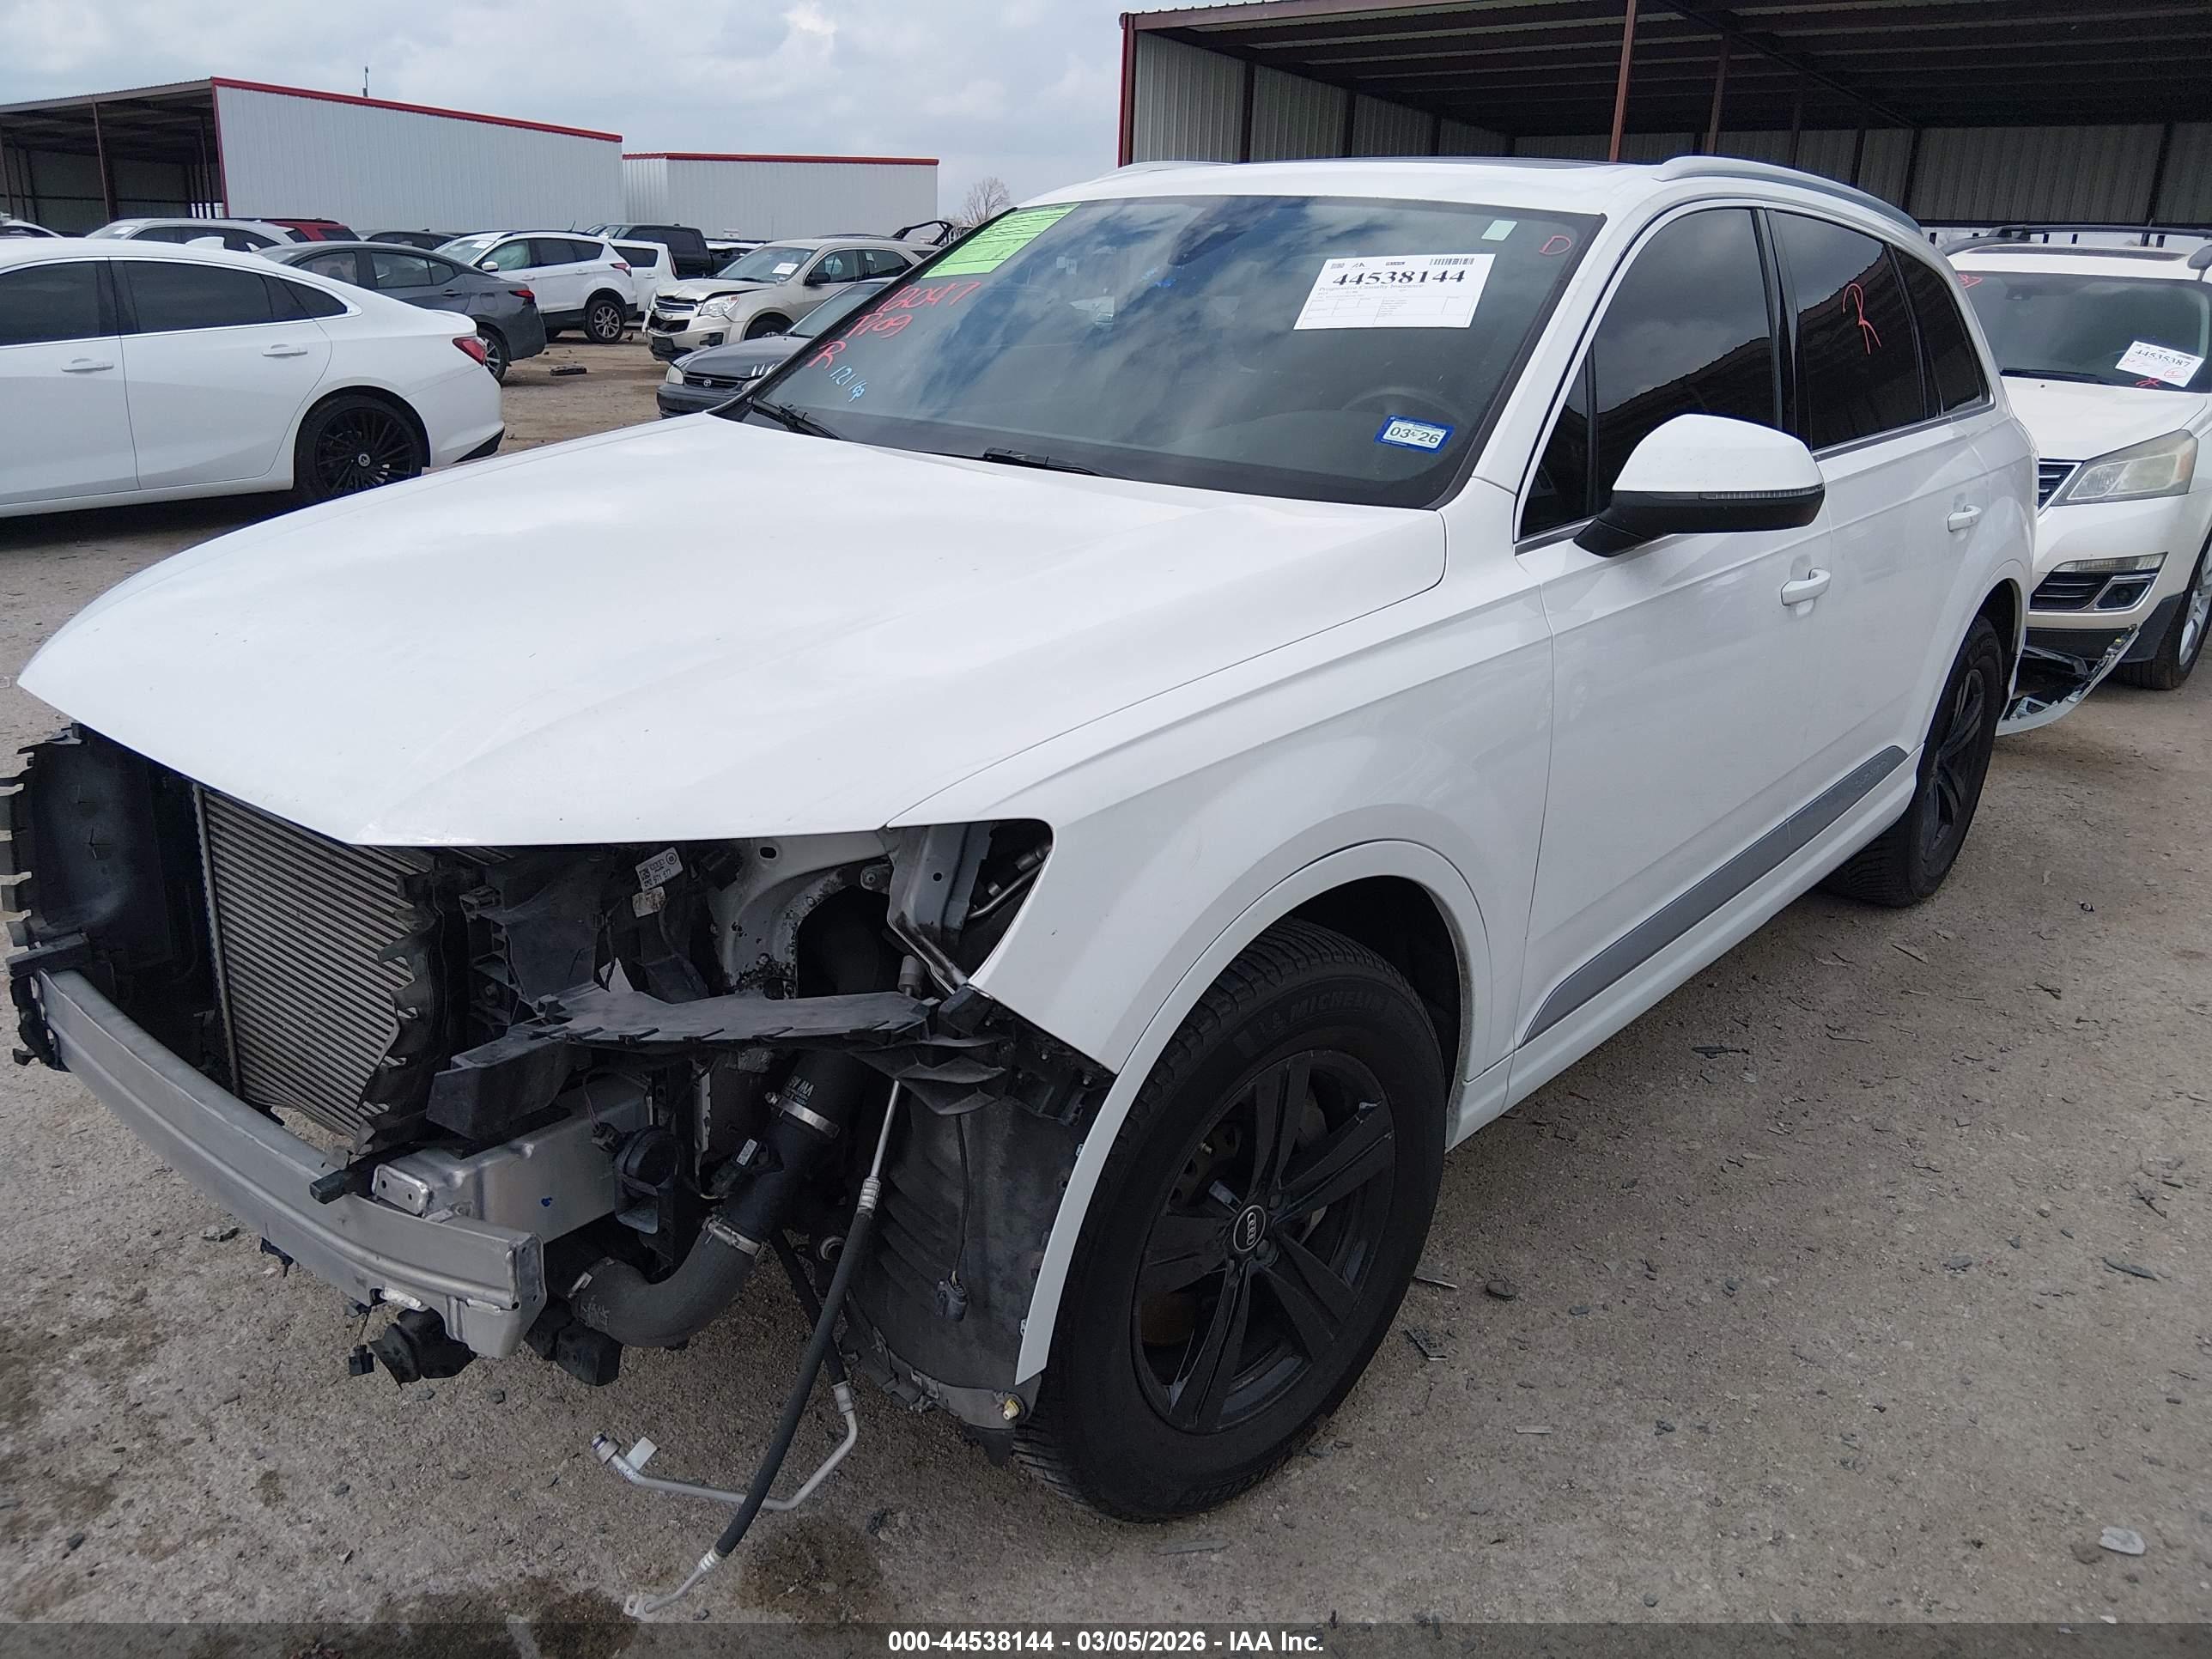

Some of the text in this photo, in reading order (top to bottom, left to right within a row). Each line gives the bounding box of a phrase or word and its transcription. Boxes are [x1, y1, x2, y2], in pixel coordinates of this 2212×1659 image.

[1332, 270, 1466, 286] 44538144
[2134, 348, 2192, 368] 44535387
[1390, 427, 1412, 439] 03
[1418, 431, 1441, 444] 26
